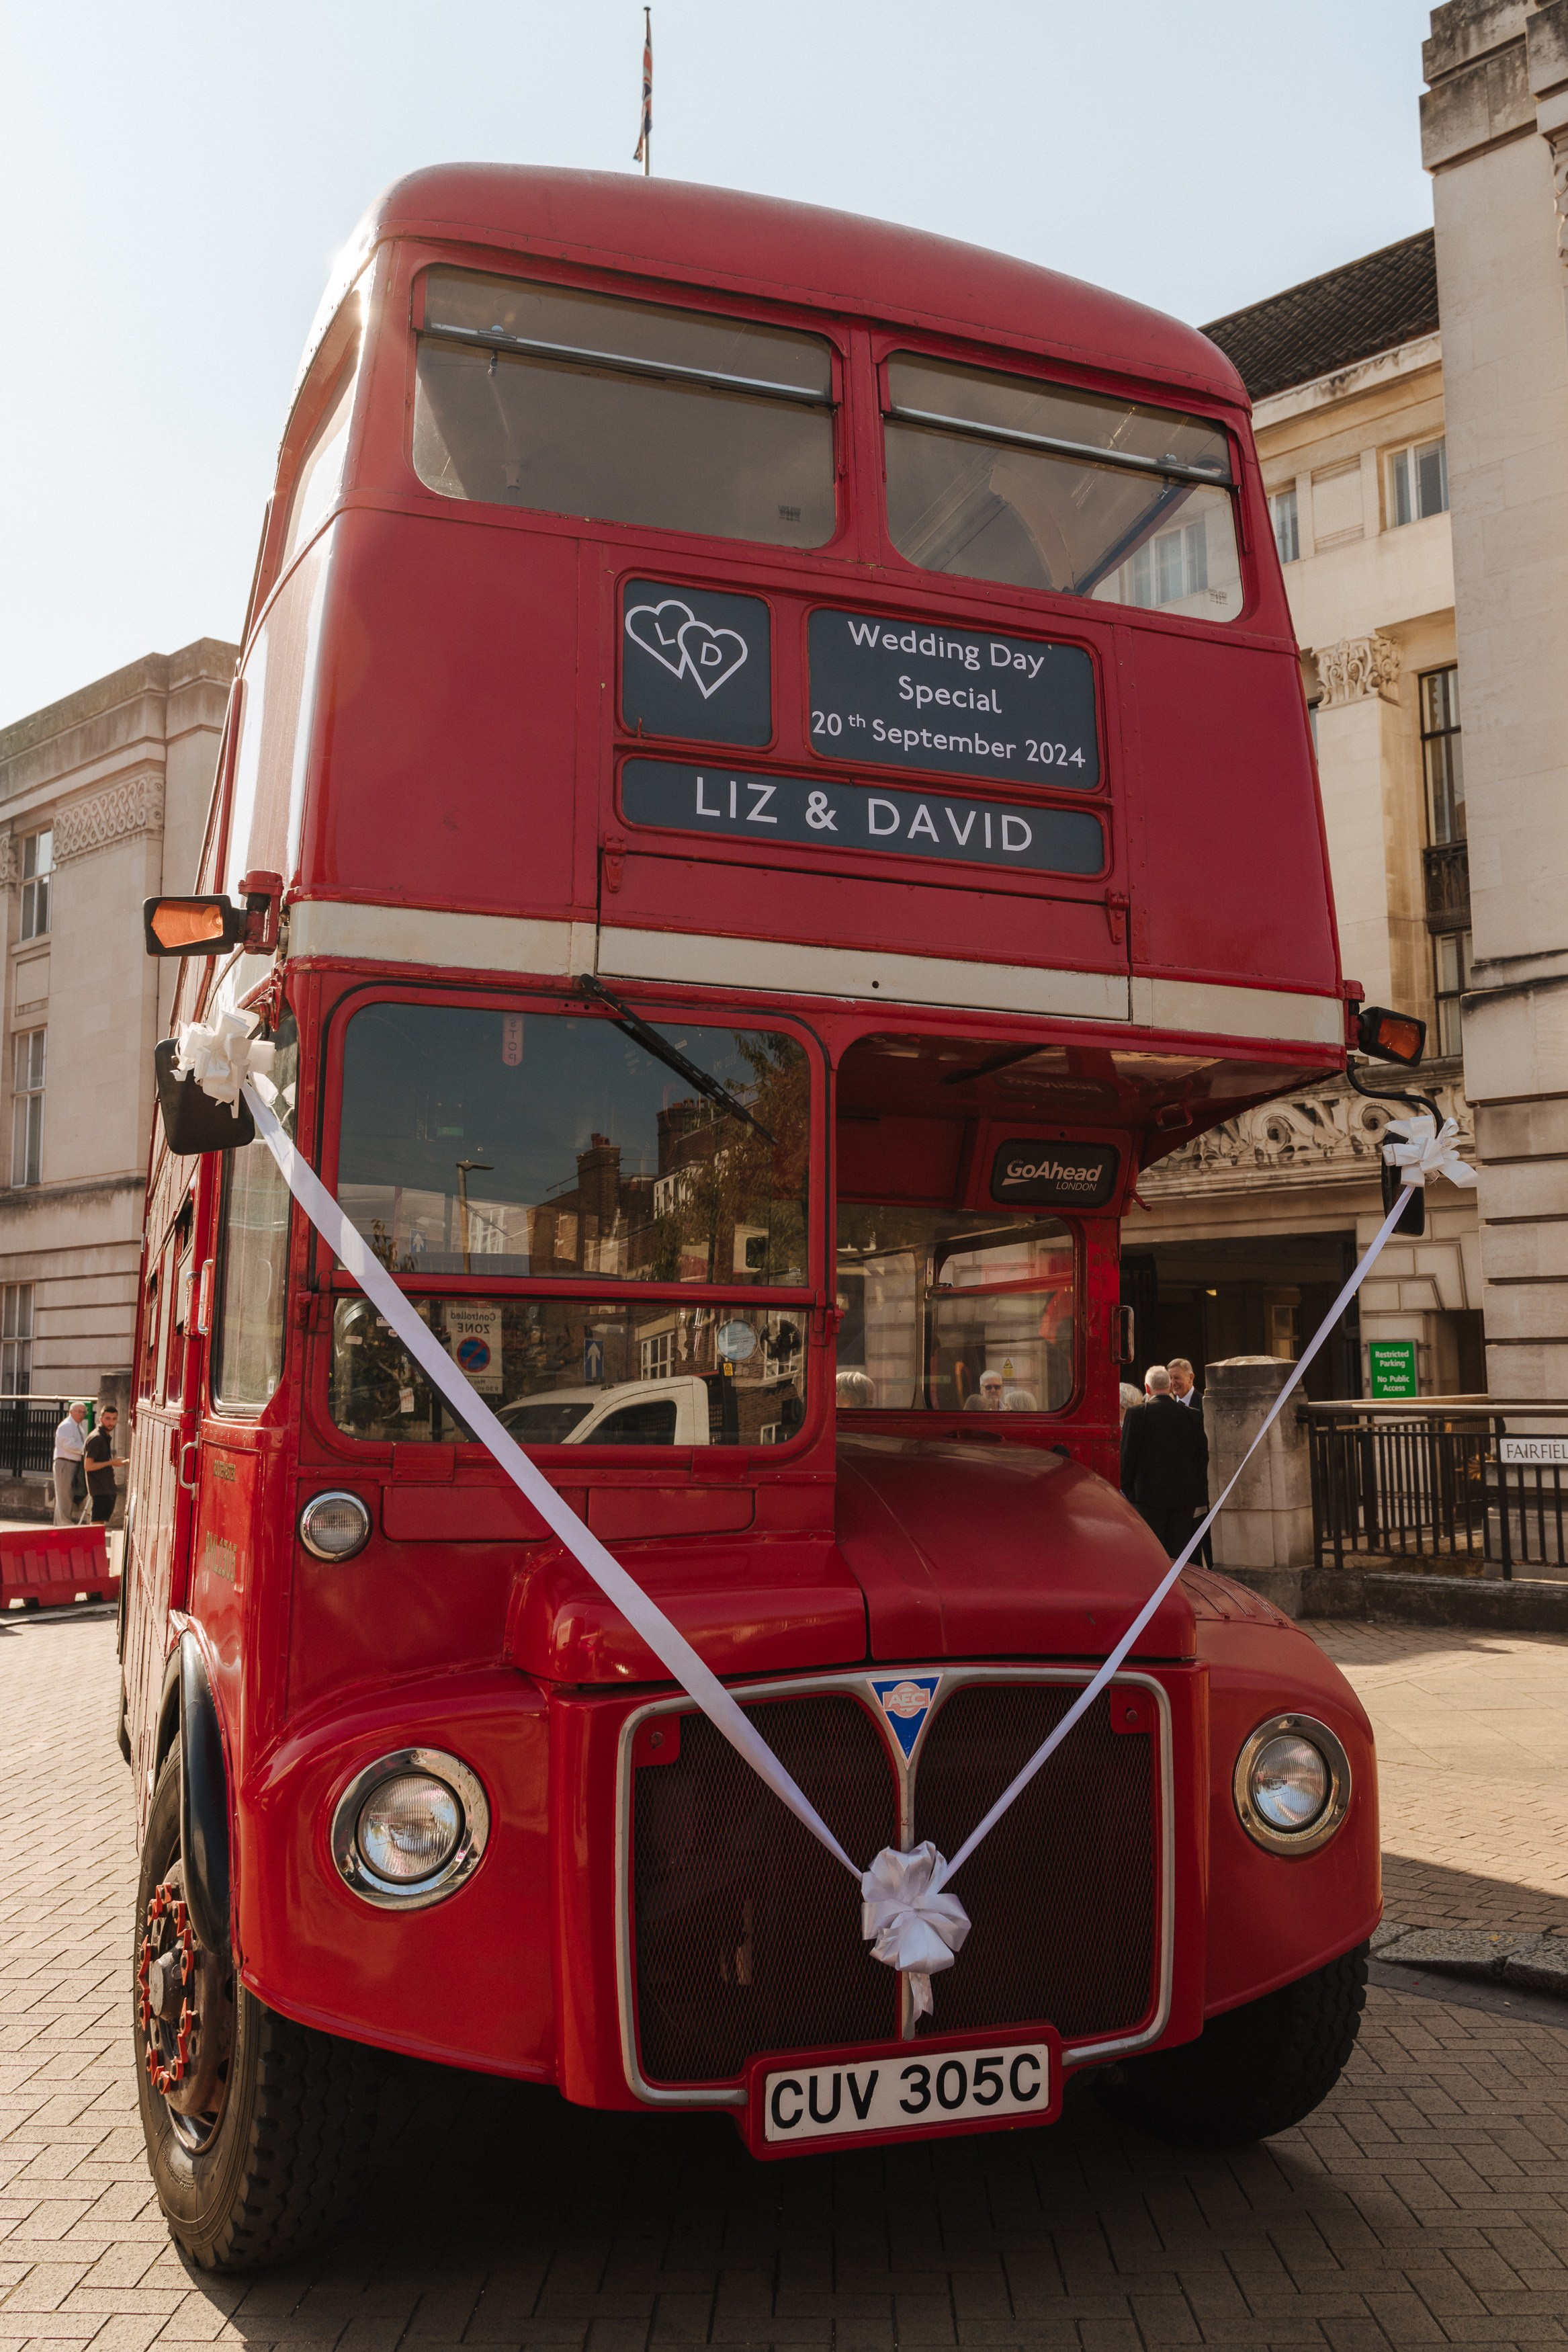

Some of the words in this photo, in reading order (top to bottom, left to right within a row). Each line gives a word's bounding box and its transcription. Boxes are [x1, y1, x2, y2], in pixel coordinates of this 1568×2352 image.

[654, 622, 677, 645] L
[847, 620, 980, 671] Wedding
[990, 643, 1045, 679] Day
[700, 641, 723, 667] D
[898, 675, 1002, 714] Special
[873, 719, 1016, 759] September
[1025, 739, 1086, 768] 2024
[695, 776, 778, 824] LIZ
[805, 790, 838, 831] &
[868, 798, 1033, 851] DAVID
[1056, 1181, 1097, 1191] LONDON
[1379, 1359, 1405, 1368] Parking
[1389, 1375, 1409, 1383] Public
[204, 1531, 238, 1583] RML2305
[887, 1692, 925, 1708] AEC
[771, 2069, 879, 2129] CUV
[899, 2053, 1041, 2115] 305C
